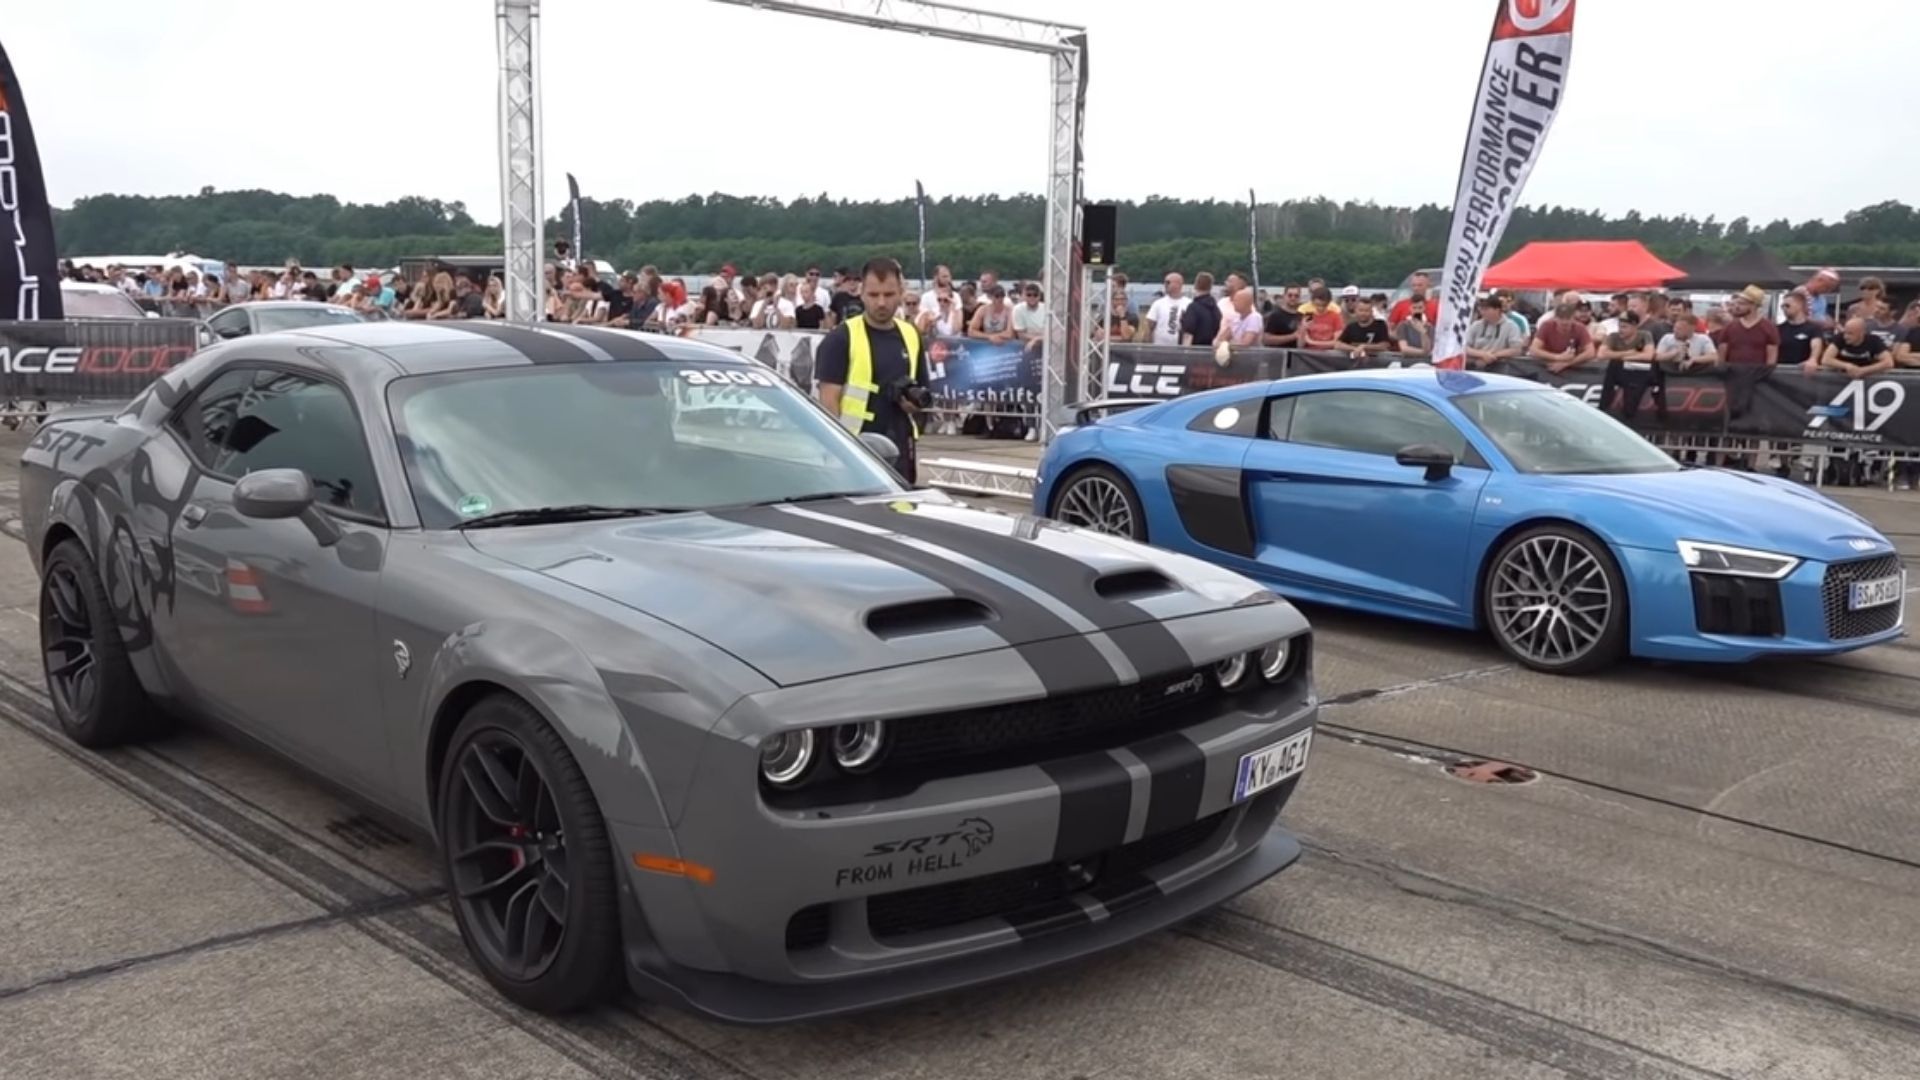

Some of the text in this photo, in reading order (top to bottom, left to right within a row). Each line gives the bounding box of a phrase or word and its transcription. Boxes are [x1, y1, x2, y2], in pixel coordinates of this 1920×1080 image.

[1463, 58, 1511, 249] PERFORMANCE
[1806, 379, 1906, 432] A9
[30, 427, 106, 462] SRT
[1802, 429, 1884, 443] PERFORMANCE
[1248, 752, 1271, 790] KY
[864, 831, 963, 857] SRT
[836, 852, 963, 888] FROM HELL
